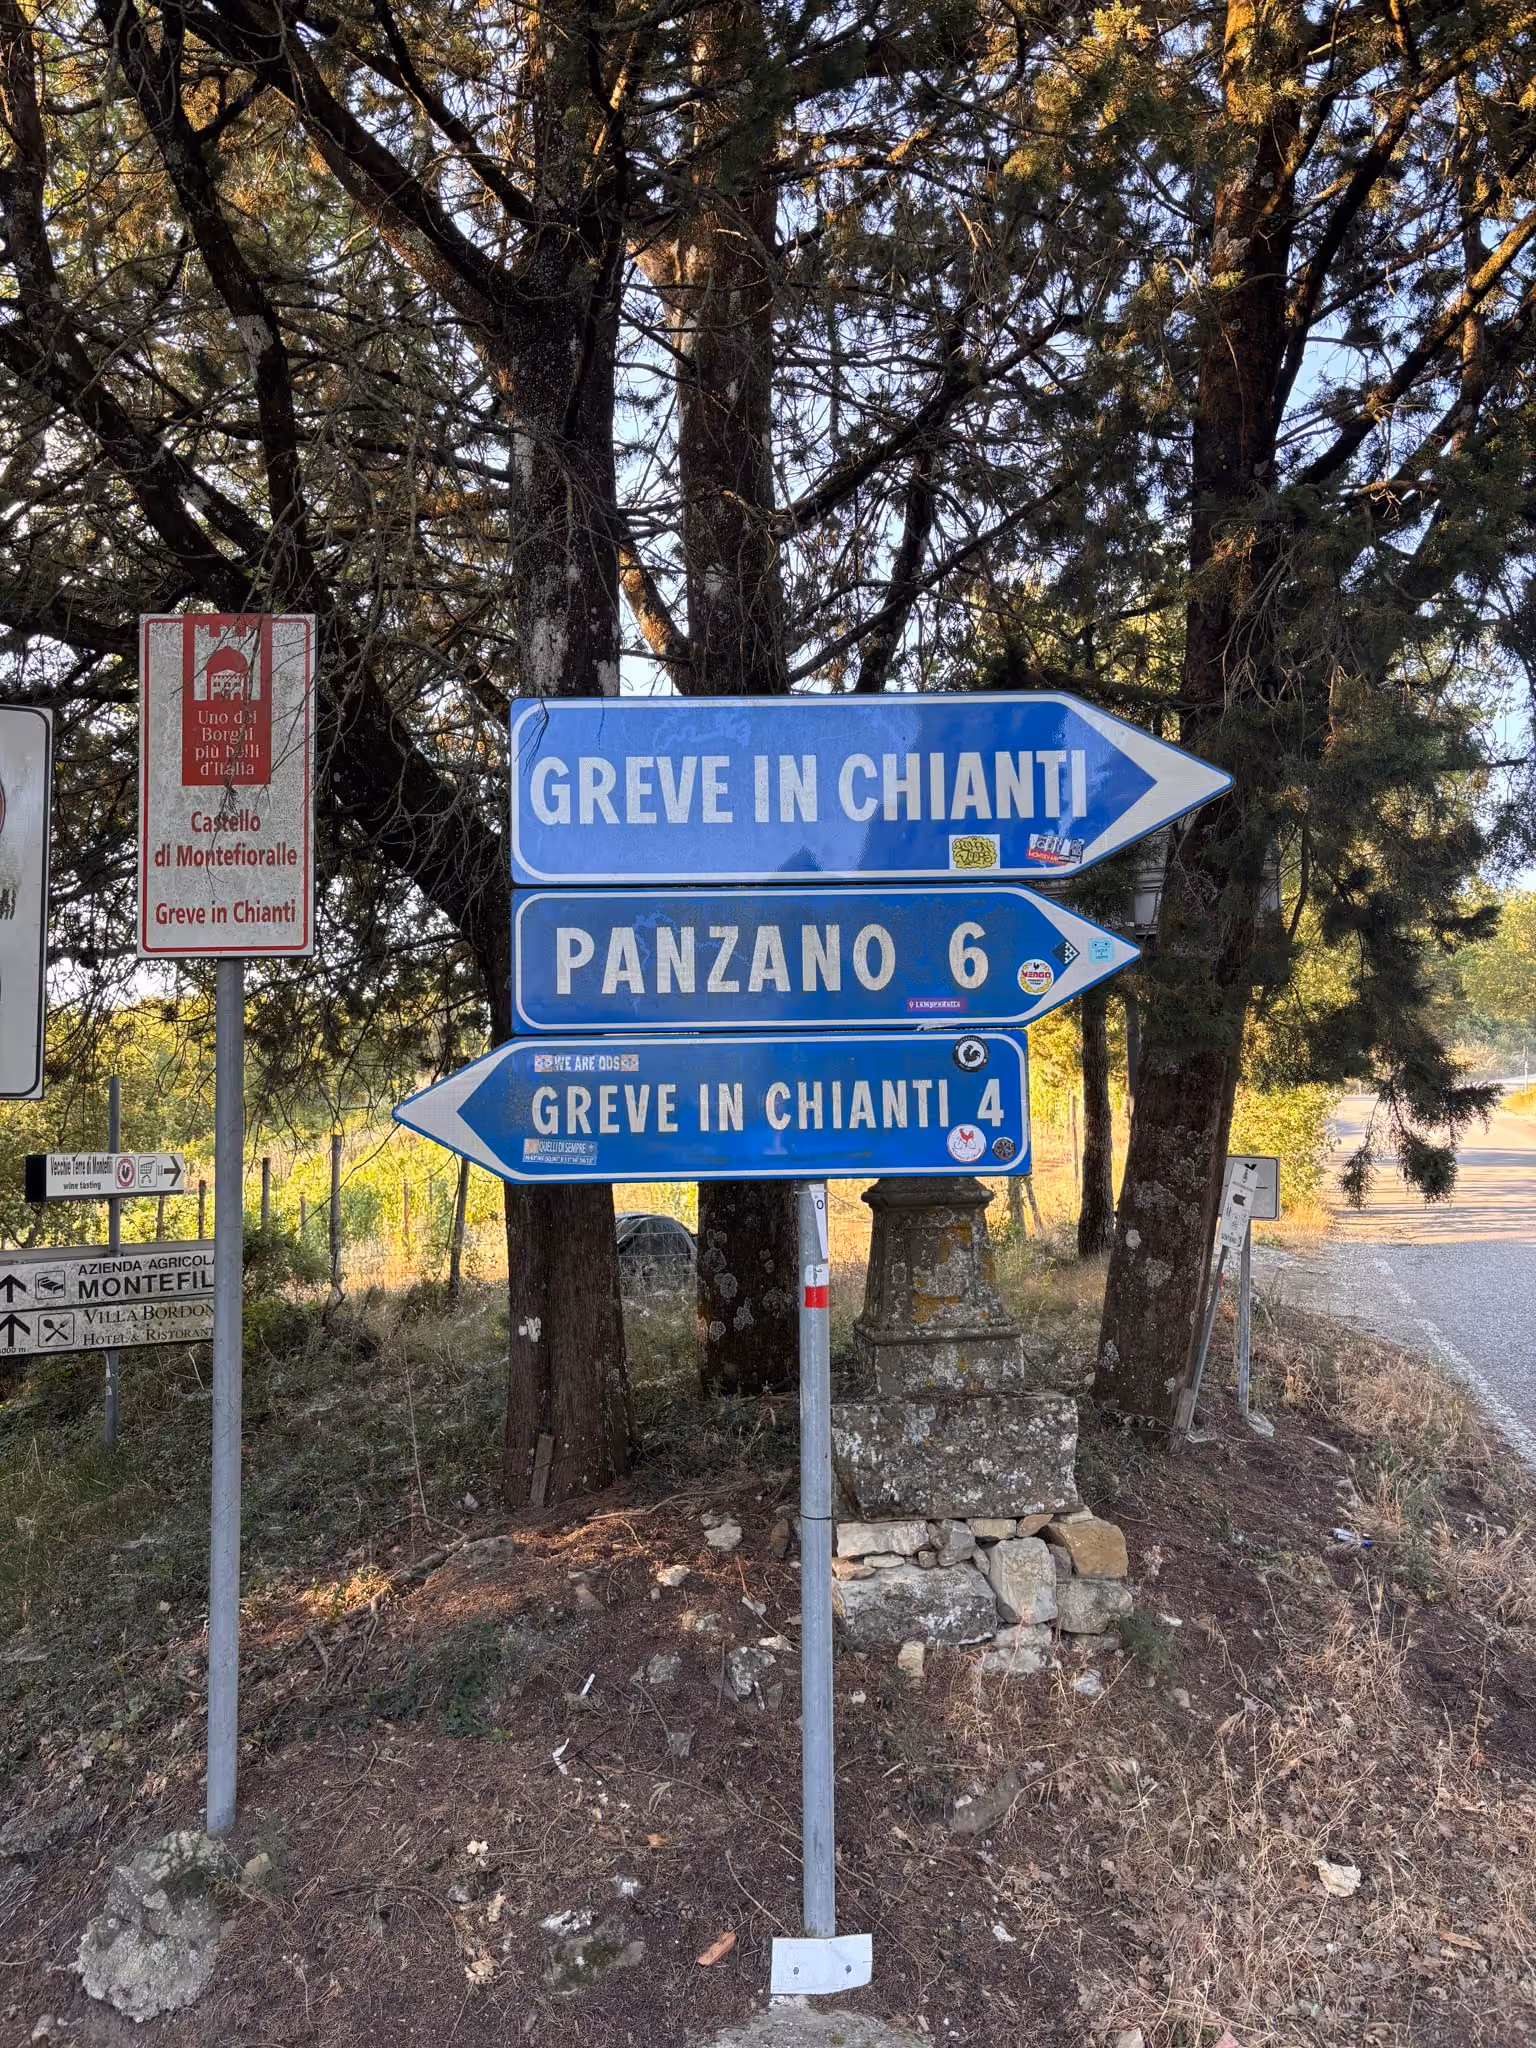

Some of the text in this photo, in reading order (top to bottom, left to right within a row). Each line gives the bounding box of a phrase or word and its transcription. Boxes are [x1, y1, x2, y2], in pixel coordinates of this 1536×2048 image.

[198, 710, 229, 725] Uno
[195, 744, 219, 760] più
[200, 761, 255, 776] d'Italia
[529, 749, 1087, 826] GREVE IN CHIANTI
[191, 809, 261, 832] Castello
[154, 842, 298, 867] di Montefioralle
[155, 899, 296, 925] Greve in Chianti
[556, 921, 989, 994] PANZANO 6
[554, 1055, 571, 1071] WE
[574, 1055, 595, 1071] ARE
[531, 1078, 1004, 1135] GREVE IN CHIANTI 4
[50, 1156, 71, 1176] Vecchie
[72, 1156, 85, 1175] Terre
[87, 1156, 92, 1174] di
[63, 1180, 102, 1191] wine tasting
[78, 1260, 142, 1276] AZIENDA
[78, 1270, 214, 1300] MONTEFIL
